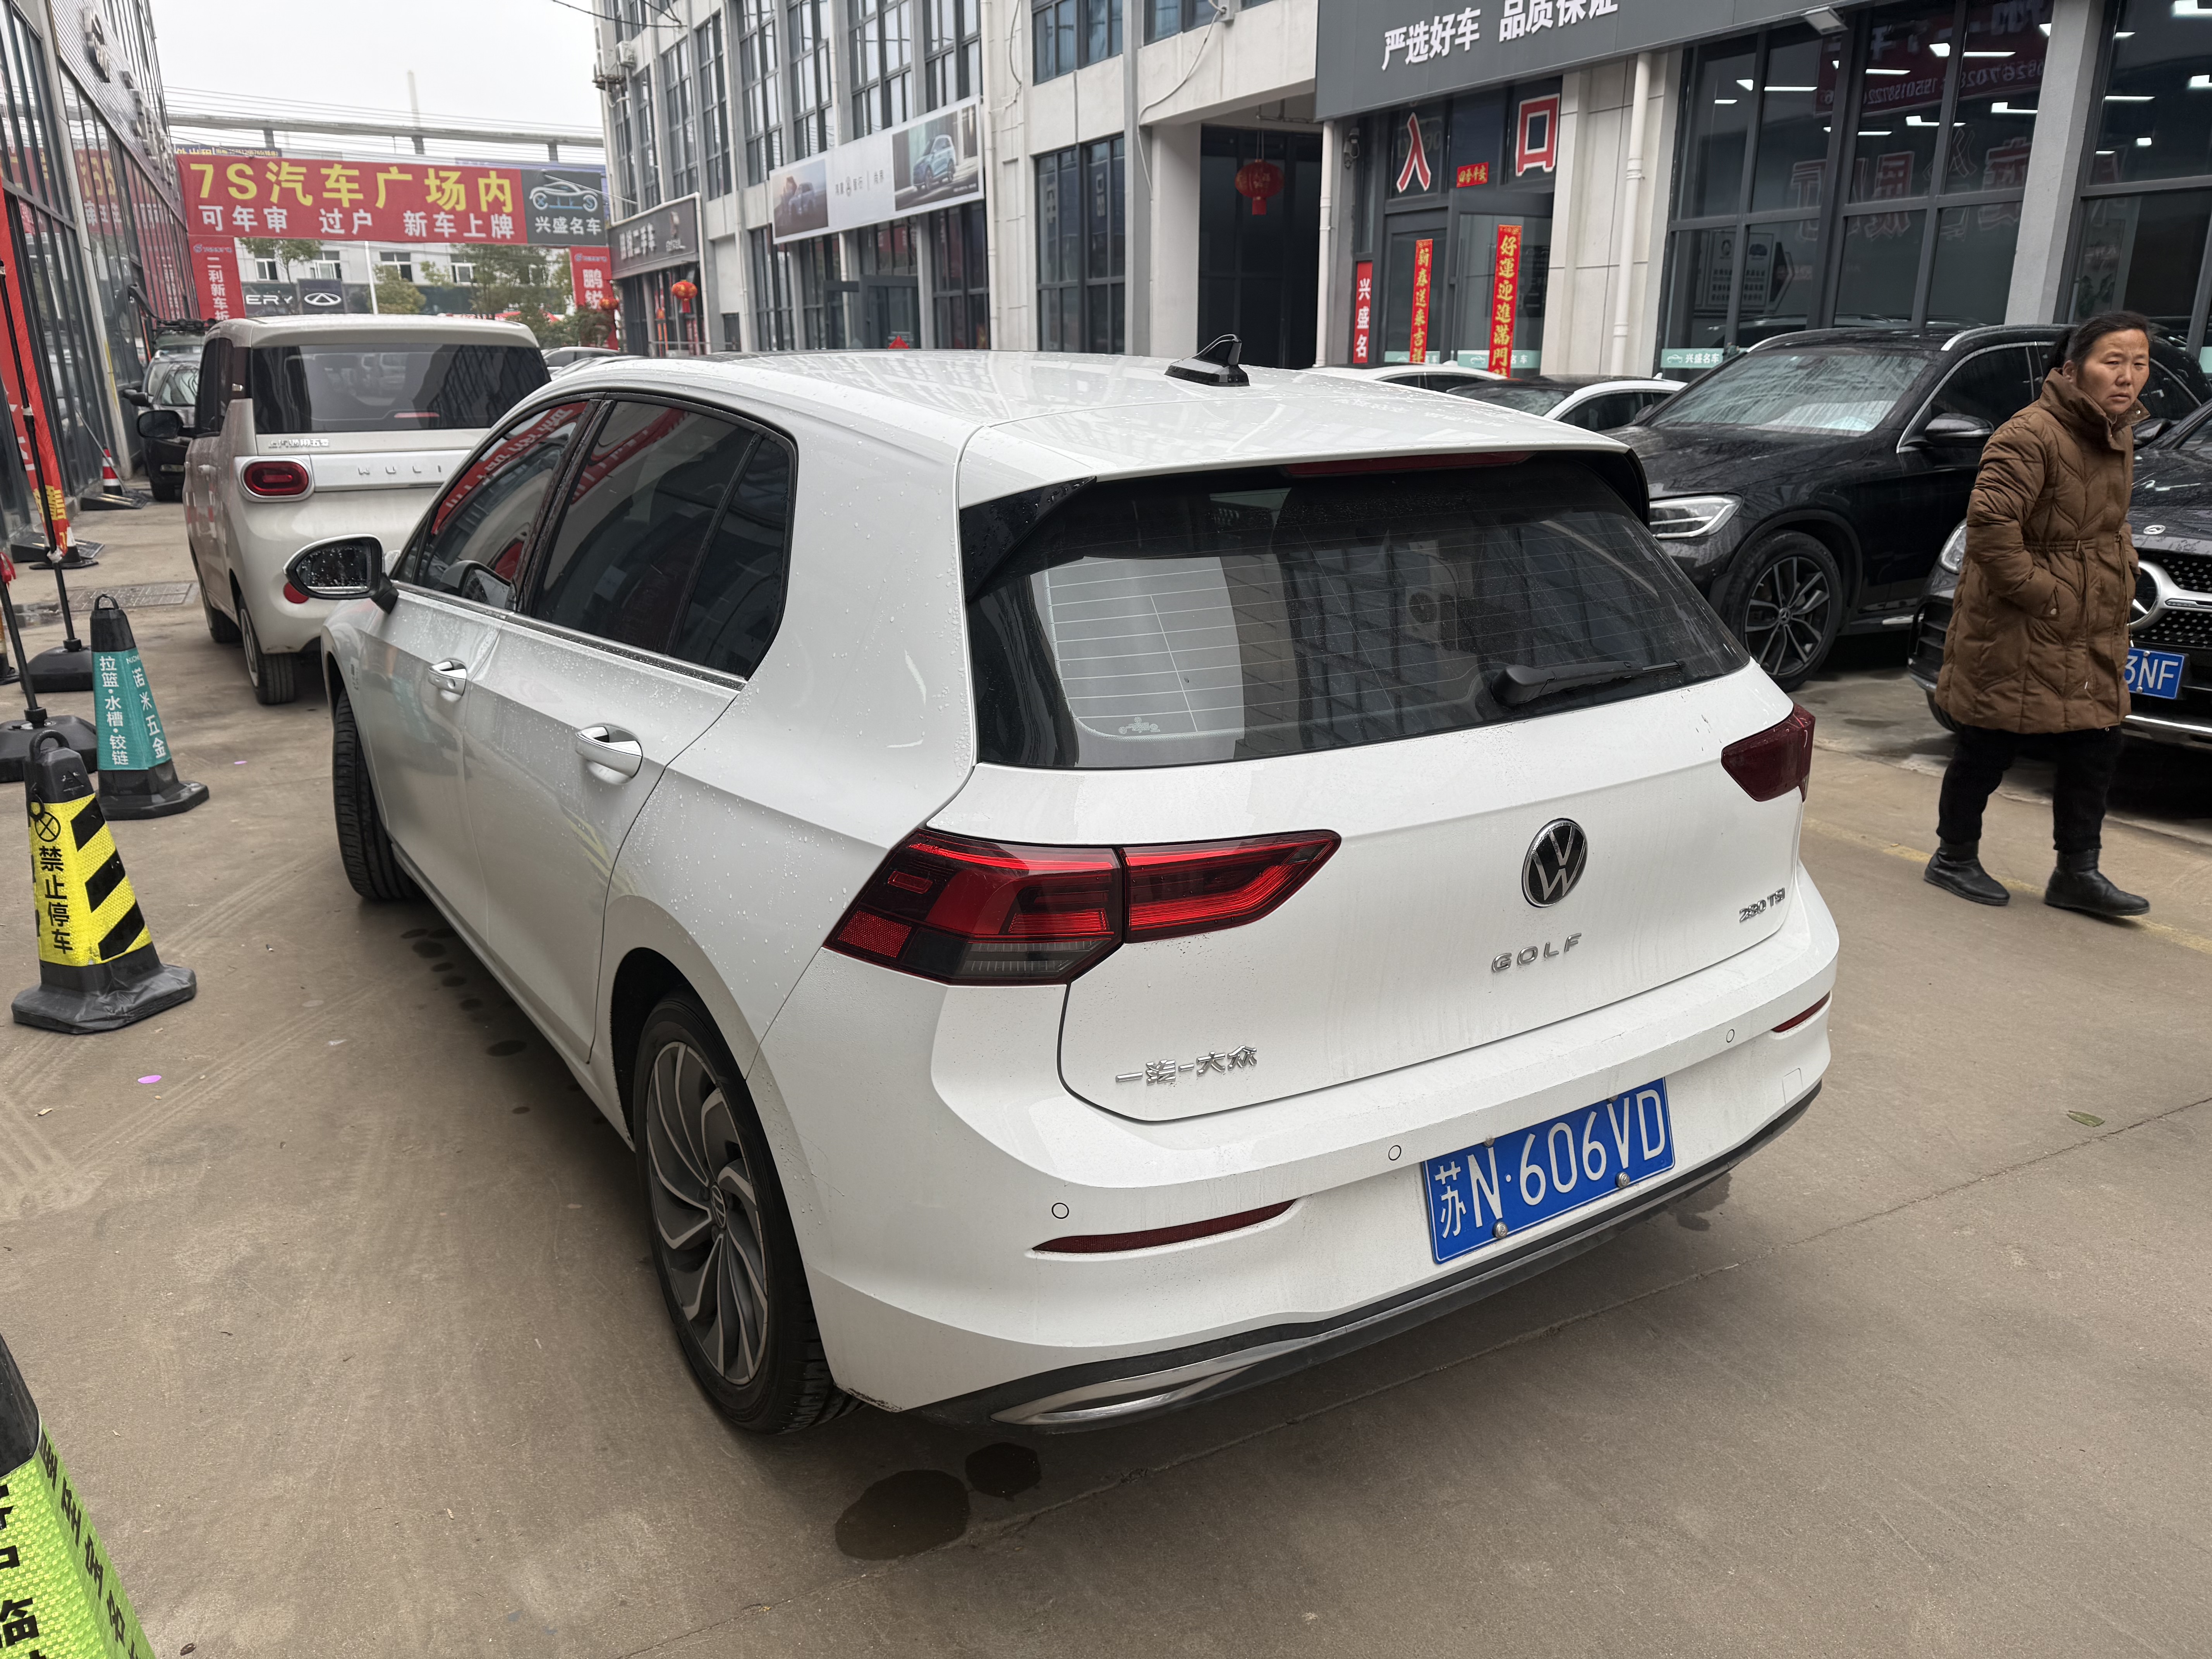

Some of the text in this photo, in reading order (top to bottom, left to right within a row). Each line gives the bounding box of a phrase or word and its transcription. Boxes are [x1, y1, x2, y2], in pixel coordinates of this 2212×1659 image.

[1381, 7, 1480, 71] 严选好车
[190, 161, 513, 213] 7S汽车广场内
[198, 205, 515, 239] 可年审 过户 新车上牌
[535, 216, 602, 235] 兴盛名车
[1685, 353, 1719, 364] 兴盛名车
[132, 667, 167, 759] 诺米五金
[39, 845, 73, 954] 禁止停车
[1767, 887, 1785, 908] TSI
[1491, 932, 1582, 973] GOLF
[1434, 1089, 1665, 1239] 苏N·606VD
